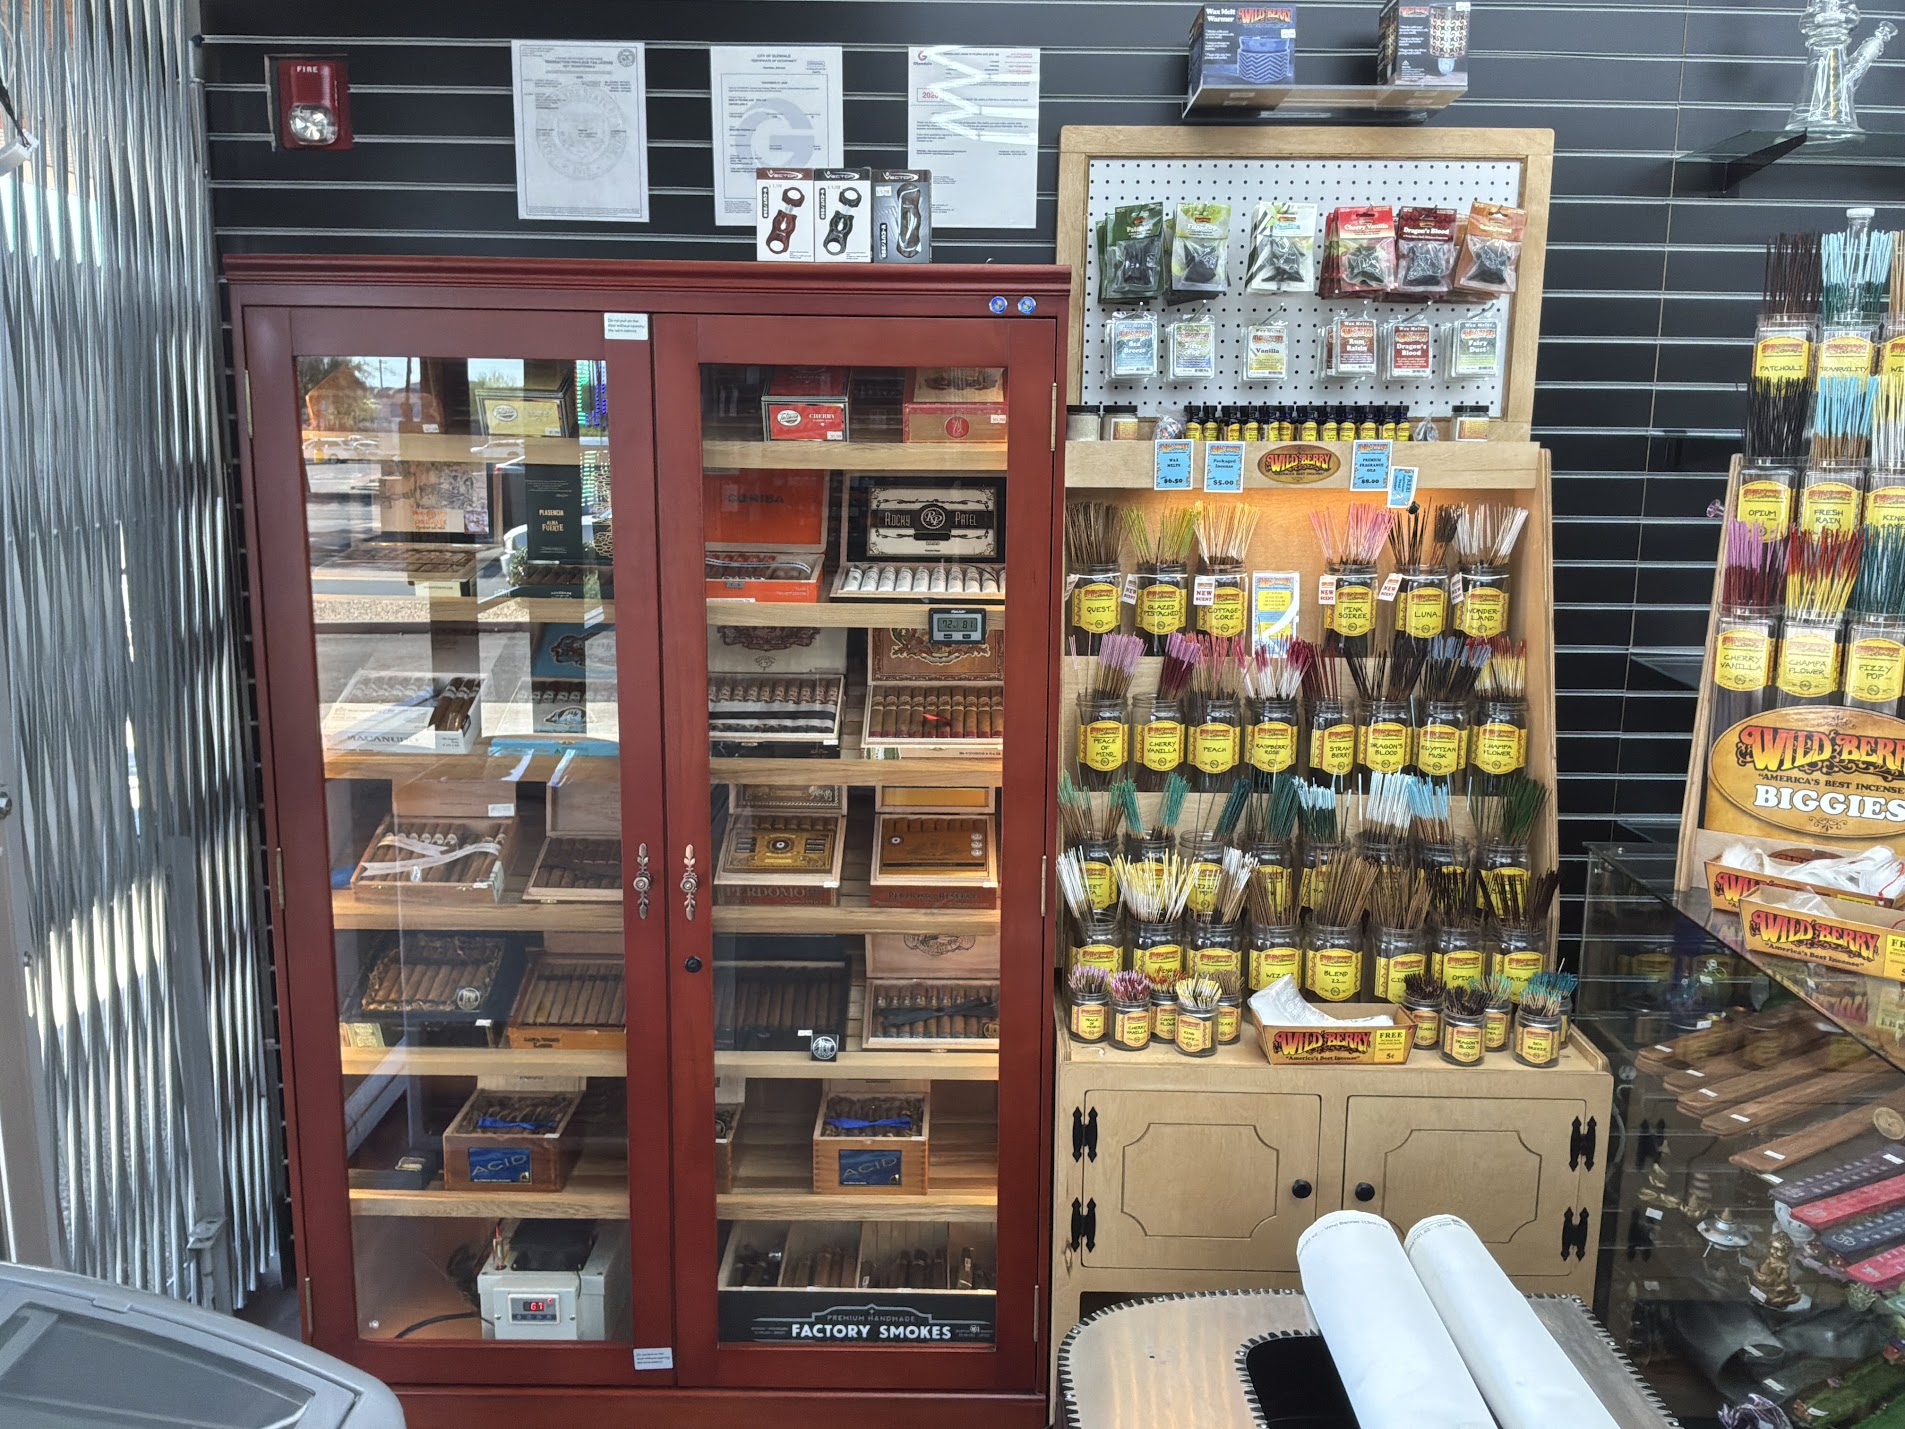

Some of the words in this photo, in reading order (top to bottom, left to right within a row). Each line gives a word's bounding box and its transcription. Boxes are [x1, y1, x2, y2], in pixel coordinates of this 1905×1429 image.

[1238, 8, 1266, 24] WILD
[1266, 8, 1292, 24] BERRY
[296, 65, 319, 74] FIRE
[767, 170, 800, 179] VECTOR
[824, 171, 857, 180] VECTOR
[883, 172, 916, 181] VECTOR
[1344, 223, 1366, 231] Cherry
[1265, 453, 1299, 472] WILD
[1299, 453, 1332, 470] BERRY
[885, 511, 911, 526] ROCKY
[955, 511, 977, 526] PATEL
[1815, 517, 1841, 525] RAIN
[541, 524, 564, 532] FUERTE
[1125, 587, 1137, 595] NEW
[1451, 586, 1462, 594] NEW
[1207, 607, 1241, 615] COTTAGE-
[1414, 611, 1437, 619] LUNA
[1723, 654, 1763, 662] CHERRY
[1720, 662, 1763, 671] VANILLA
[1788, 659, 1826, 667] CHAMPA
[1788, 667, 1826, 675] FLOWER
[1858, 664, 1894, 673] FIZZY
[1865, 672, 1884, 680] POP
[1149, 740, 1177, 748] CHERRY
[1255, 743, 1290, 751] RASPBERRY
[1369, 742, 1404, 750] DRAGON'S
[1737, 725, 1833, 772] WILD
[1420, 745, 1457, 753] EGYPTIAN
[1824, 779, 1853, 790] BEST
[1753, 784, 1905, 822] BIGGIES
[726, 885, 806, 898] PERDOMO
[1750, 909, 1814, 944] WILD
[1815, 922, 1881, 962] BERRY
[1809, 951, 1828, 962] Best
[1273, 1031, 1322, 1055] WILD
[1322, 1031, 1372, 1053] BERRY
[471, 1155, 527, 1176] ACID
[843, 1156, 898, 1178] ACID
[827, 1314, 865, 1322] PREMIUM
[867, 1315, 915, 1323] HANDMADE
[791, 1323, 871, 1338] FACTORY
[879, 1325, 952, 1339] SMOKES
